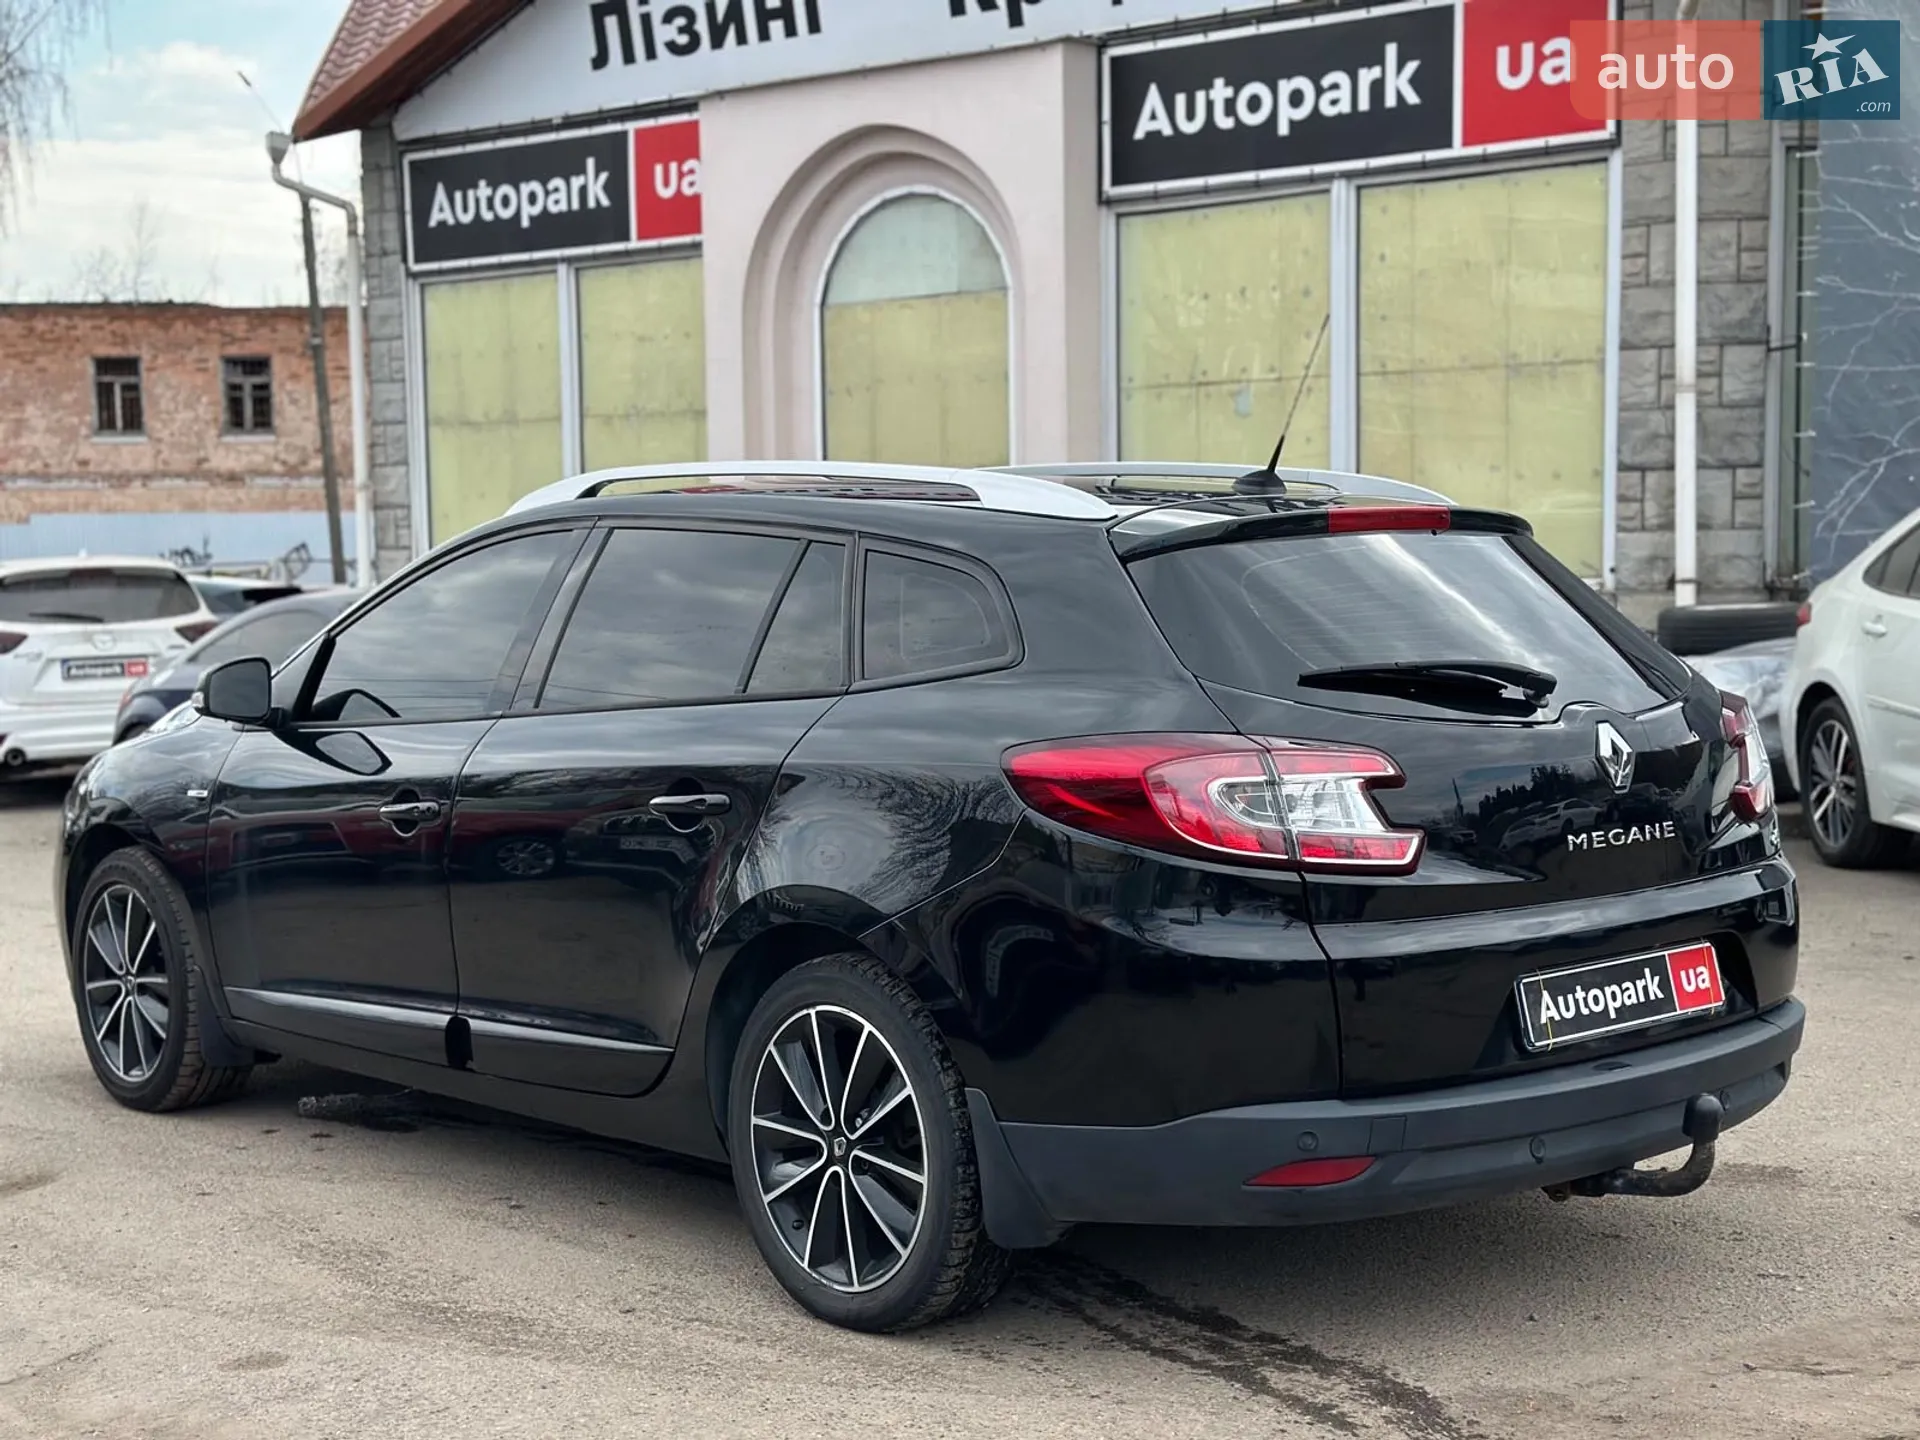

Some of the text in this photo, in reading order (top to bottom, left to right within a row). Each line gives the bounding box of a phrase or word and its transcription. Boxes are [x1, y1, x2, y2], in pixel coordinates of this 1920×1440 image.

[1133, 36, 1576, 140] Autopark ua
[428, 157, 702, 229] Autopark ua
[1567, 821, 1676, 851] MEGANE
[1539, 964, 1711, 1024] Autopark ua
